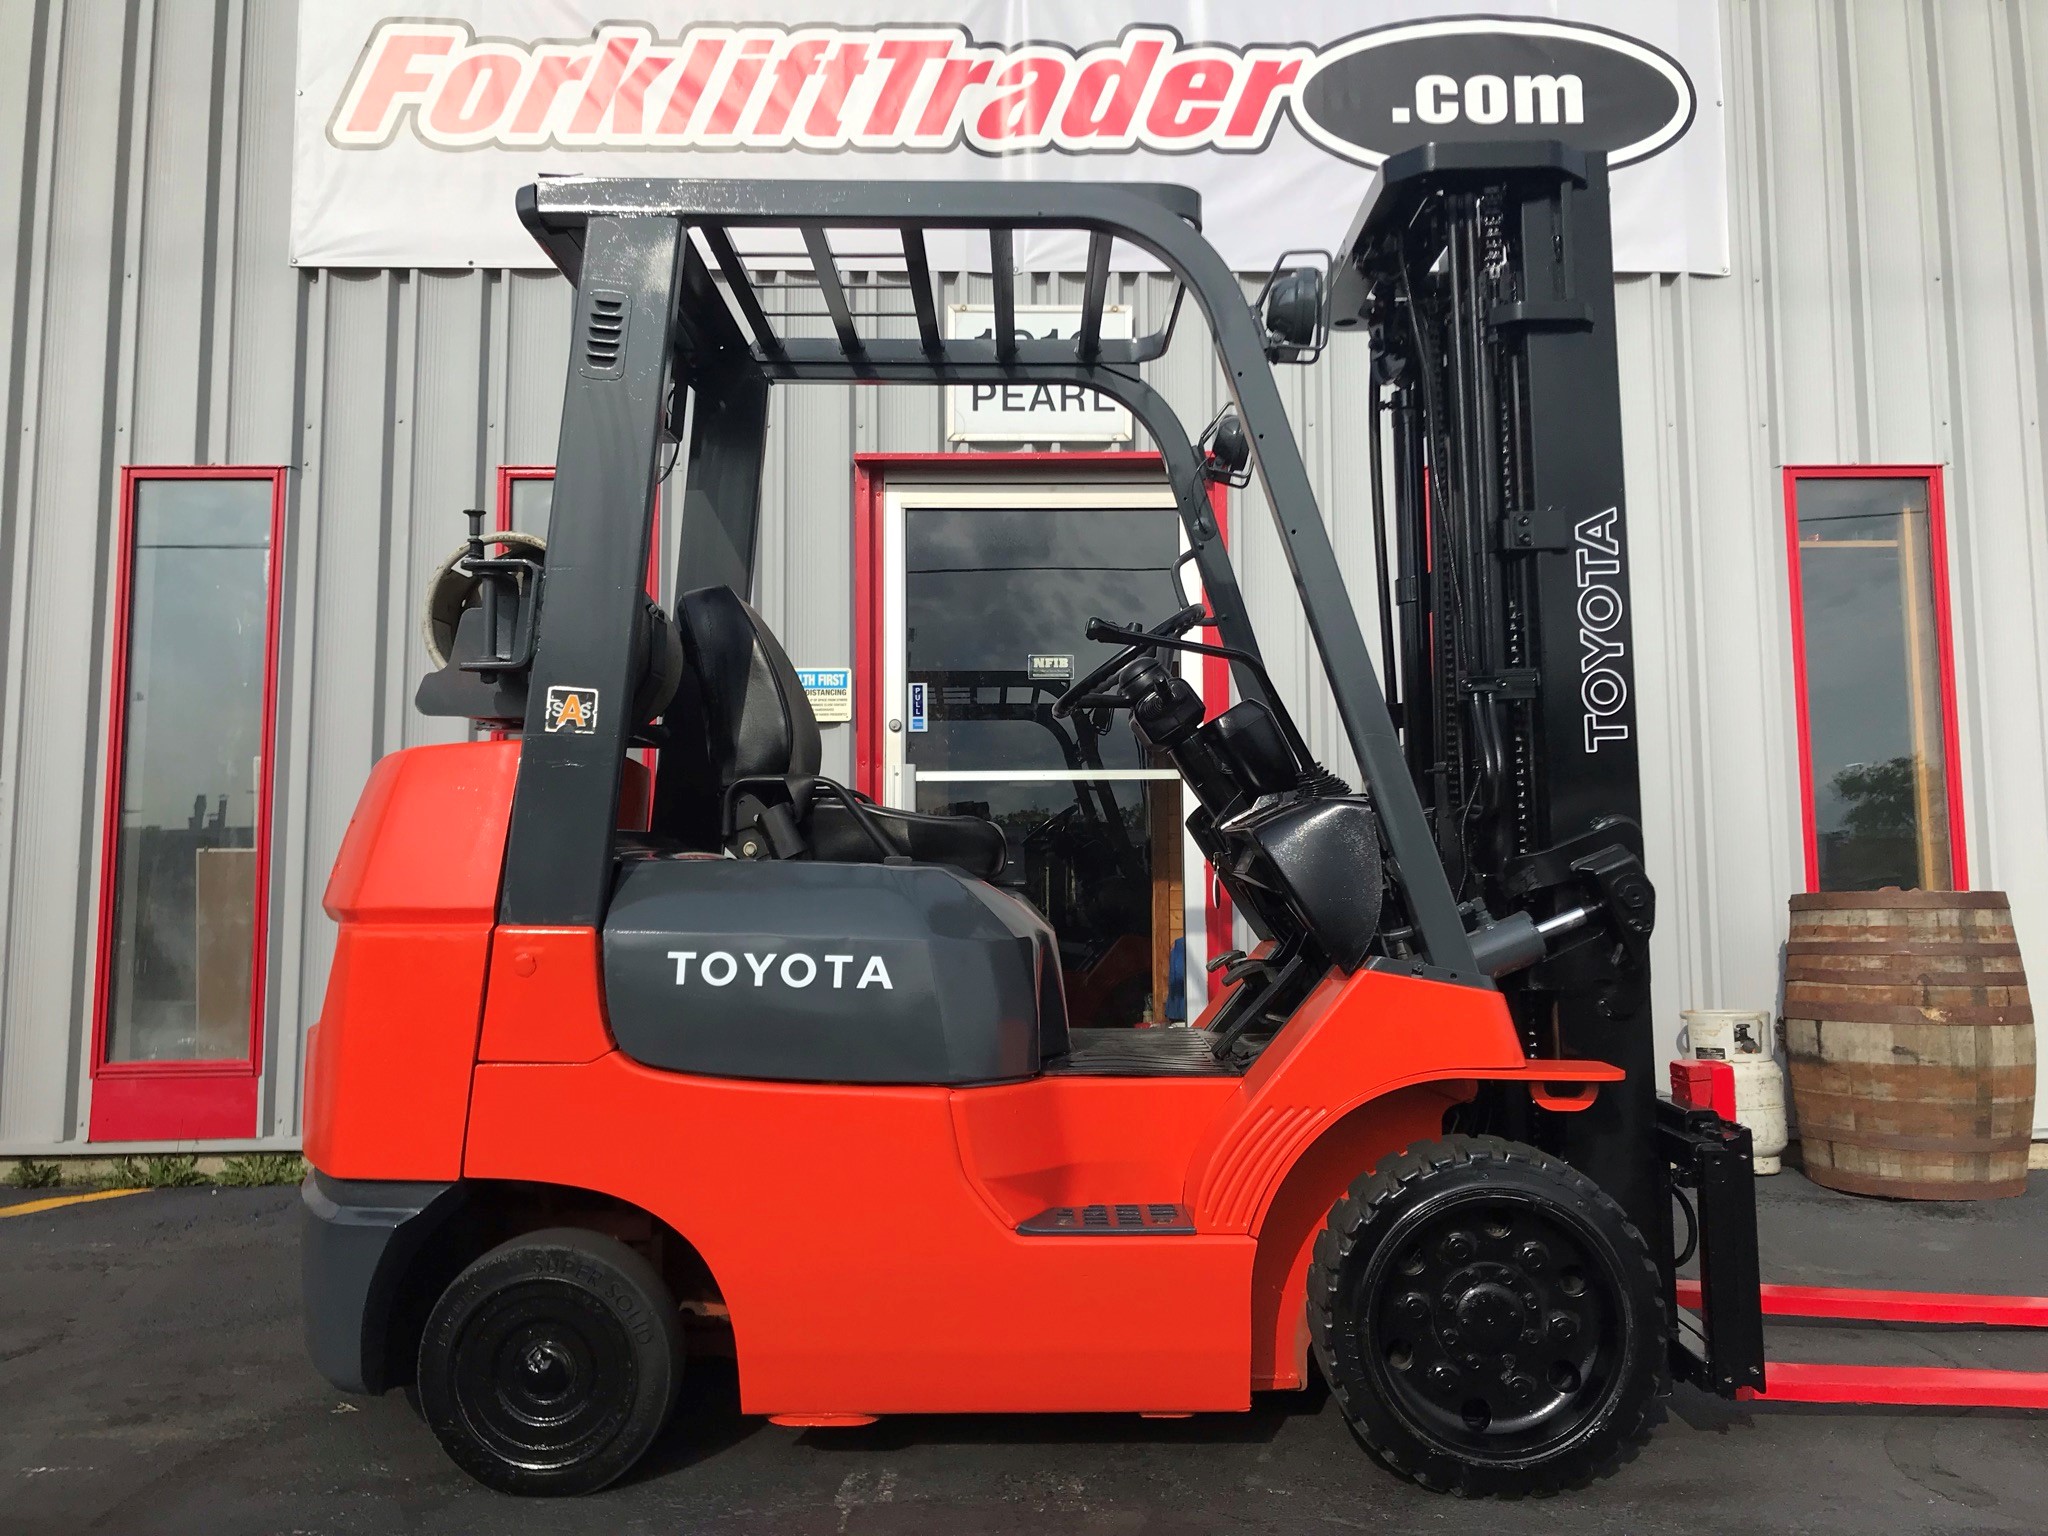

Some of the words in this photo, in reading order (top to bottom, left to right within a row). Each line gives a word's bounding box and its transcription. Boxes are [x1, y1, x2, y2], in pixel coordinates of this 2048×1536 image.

[972, 384, 1116, 412] PEARL
[1574, 506, 1629, 753] TOYOTA
[1033, 657, 1069, 668] NFIB
[818, 673, 845, 686] FIRST
[667, 951, 894, 990] TOYOTA
[533, 1255, 603, 1288] SUPER
[604, 1282, 656, 1346] SOLID
